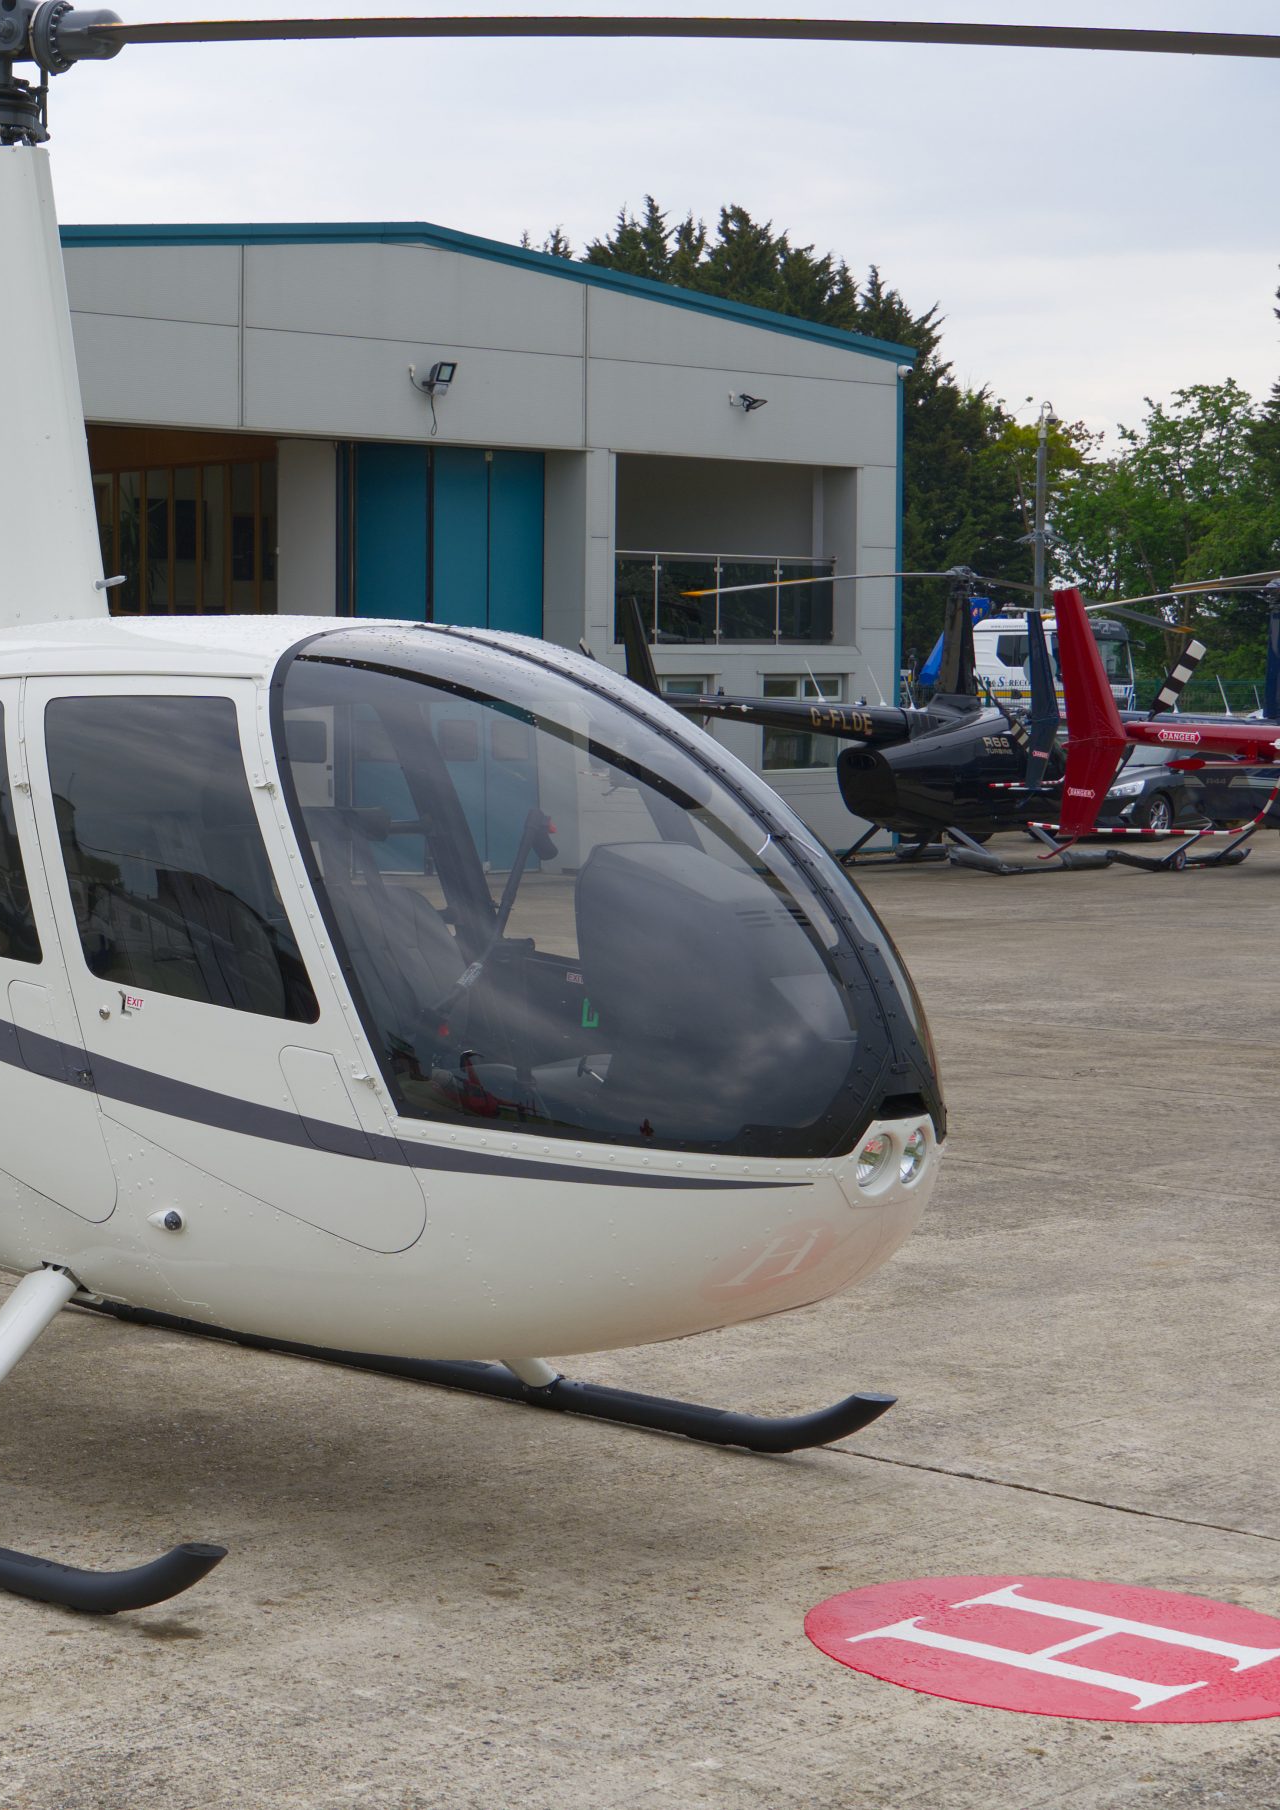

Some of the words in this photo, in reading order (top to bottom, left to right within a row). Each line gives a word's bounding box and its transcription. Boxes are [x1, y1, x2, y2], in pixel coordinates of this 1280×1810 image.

[982, 736, 1010, 748] R66
[1162, 731, 1196, 742] DANGER
[985, 747, 1014, 755] TURBINE
[1070, 788, 1092, 798] DANGER
[127, 996, 144, 1008] EXIT
[844, 1582, 1280, 1711] H
